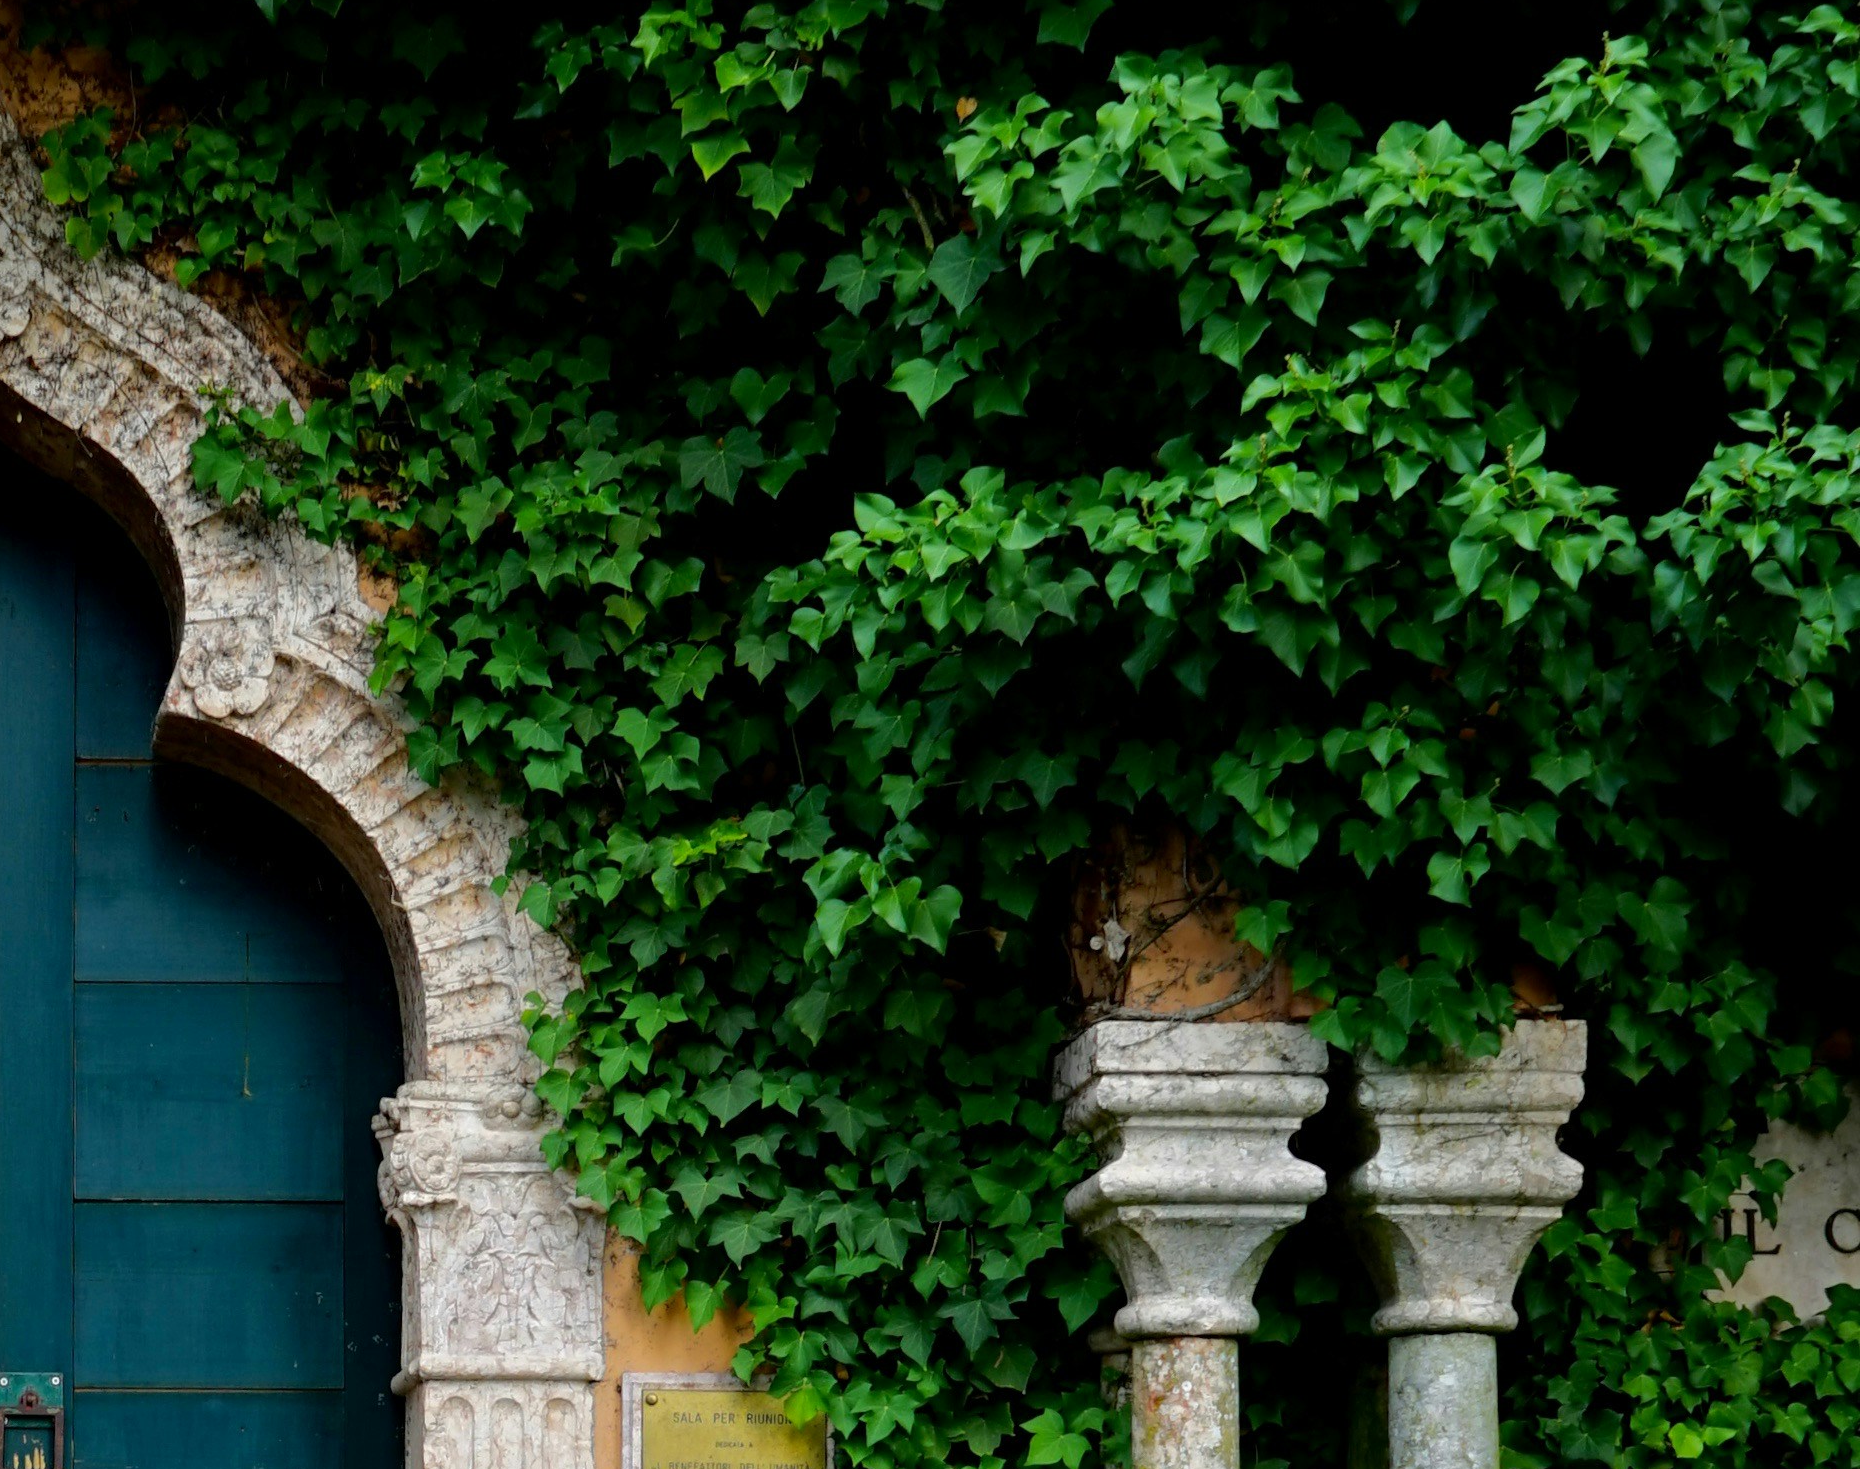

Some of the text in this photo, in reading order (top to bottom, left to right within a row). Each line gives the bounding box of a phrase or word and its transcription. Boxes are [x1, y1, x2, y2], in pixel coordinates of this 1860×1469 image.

[673, 1413, 793, 1425] SALA PER RIUNION
